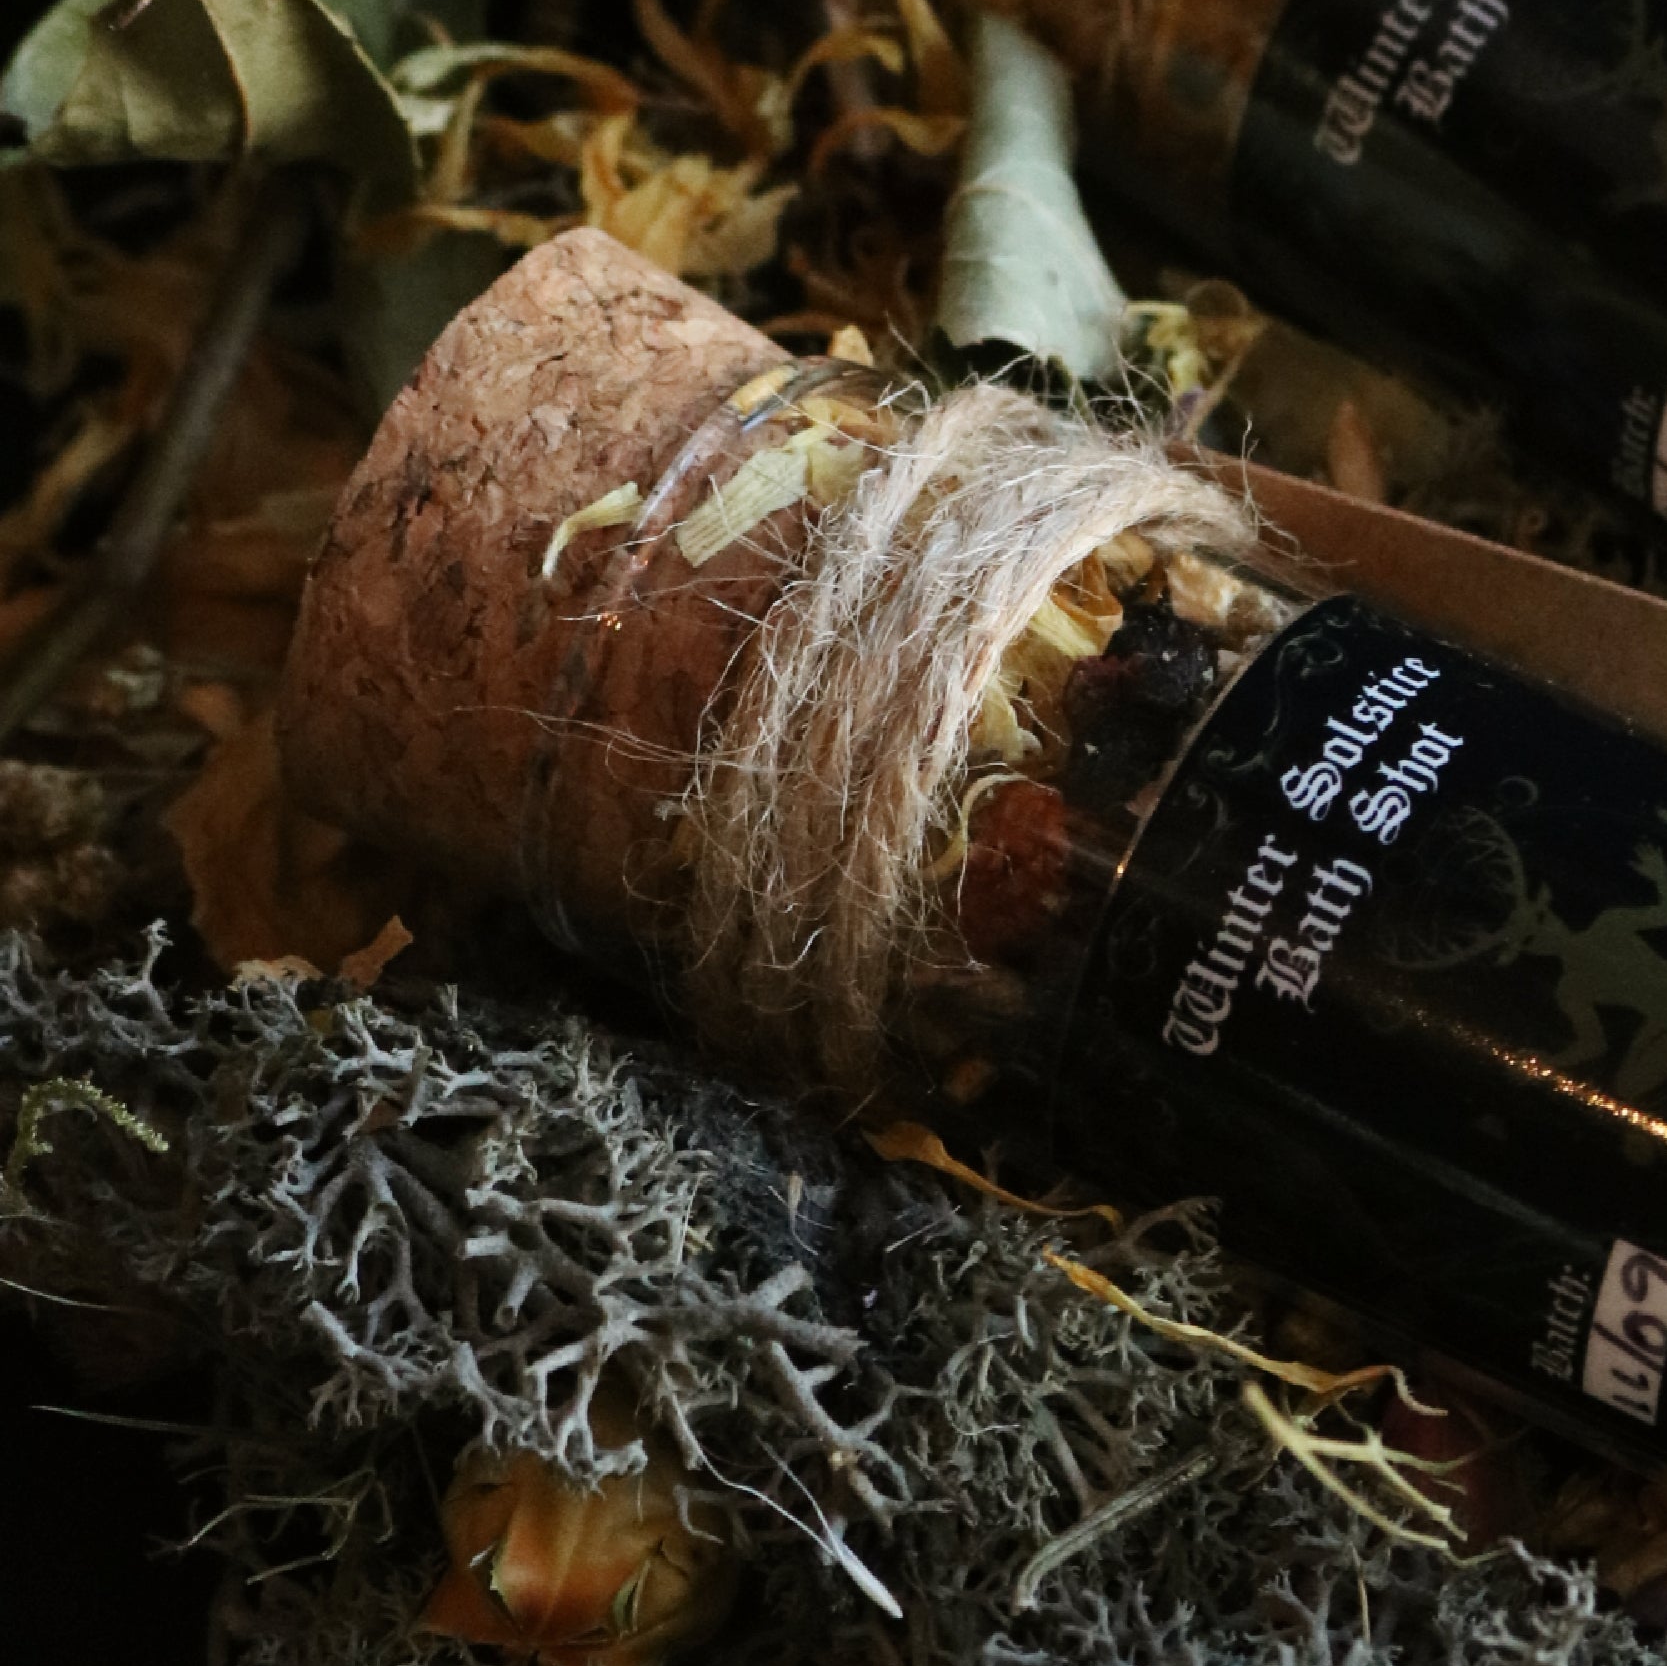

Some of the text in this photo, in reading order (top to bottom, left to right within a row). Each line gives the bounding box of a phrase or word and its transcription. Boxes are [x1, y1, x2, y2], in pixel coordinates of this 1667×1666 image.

[1164, 654, 1440, 1055] Winter Solstice
[1255, 722, 1464, 1014] Bath Shot
